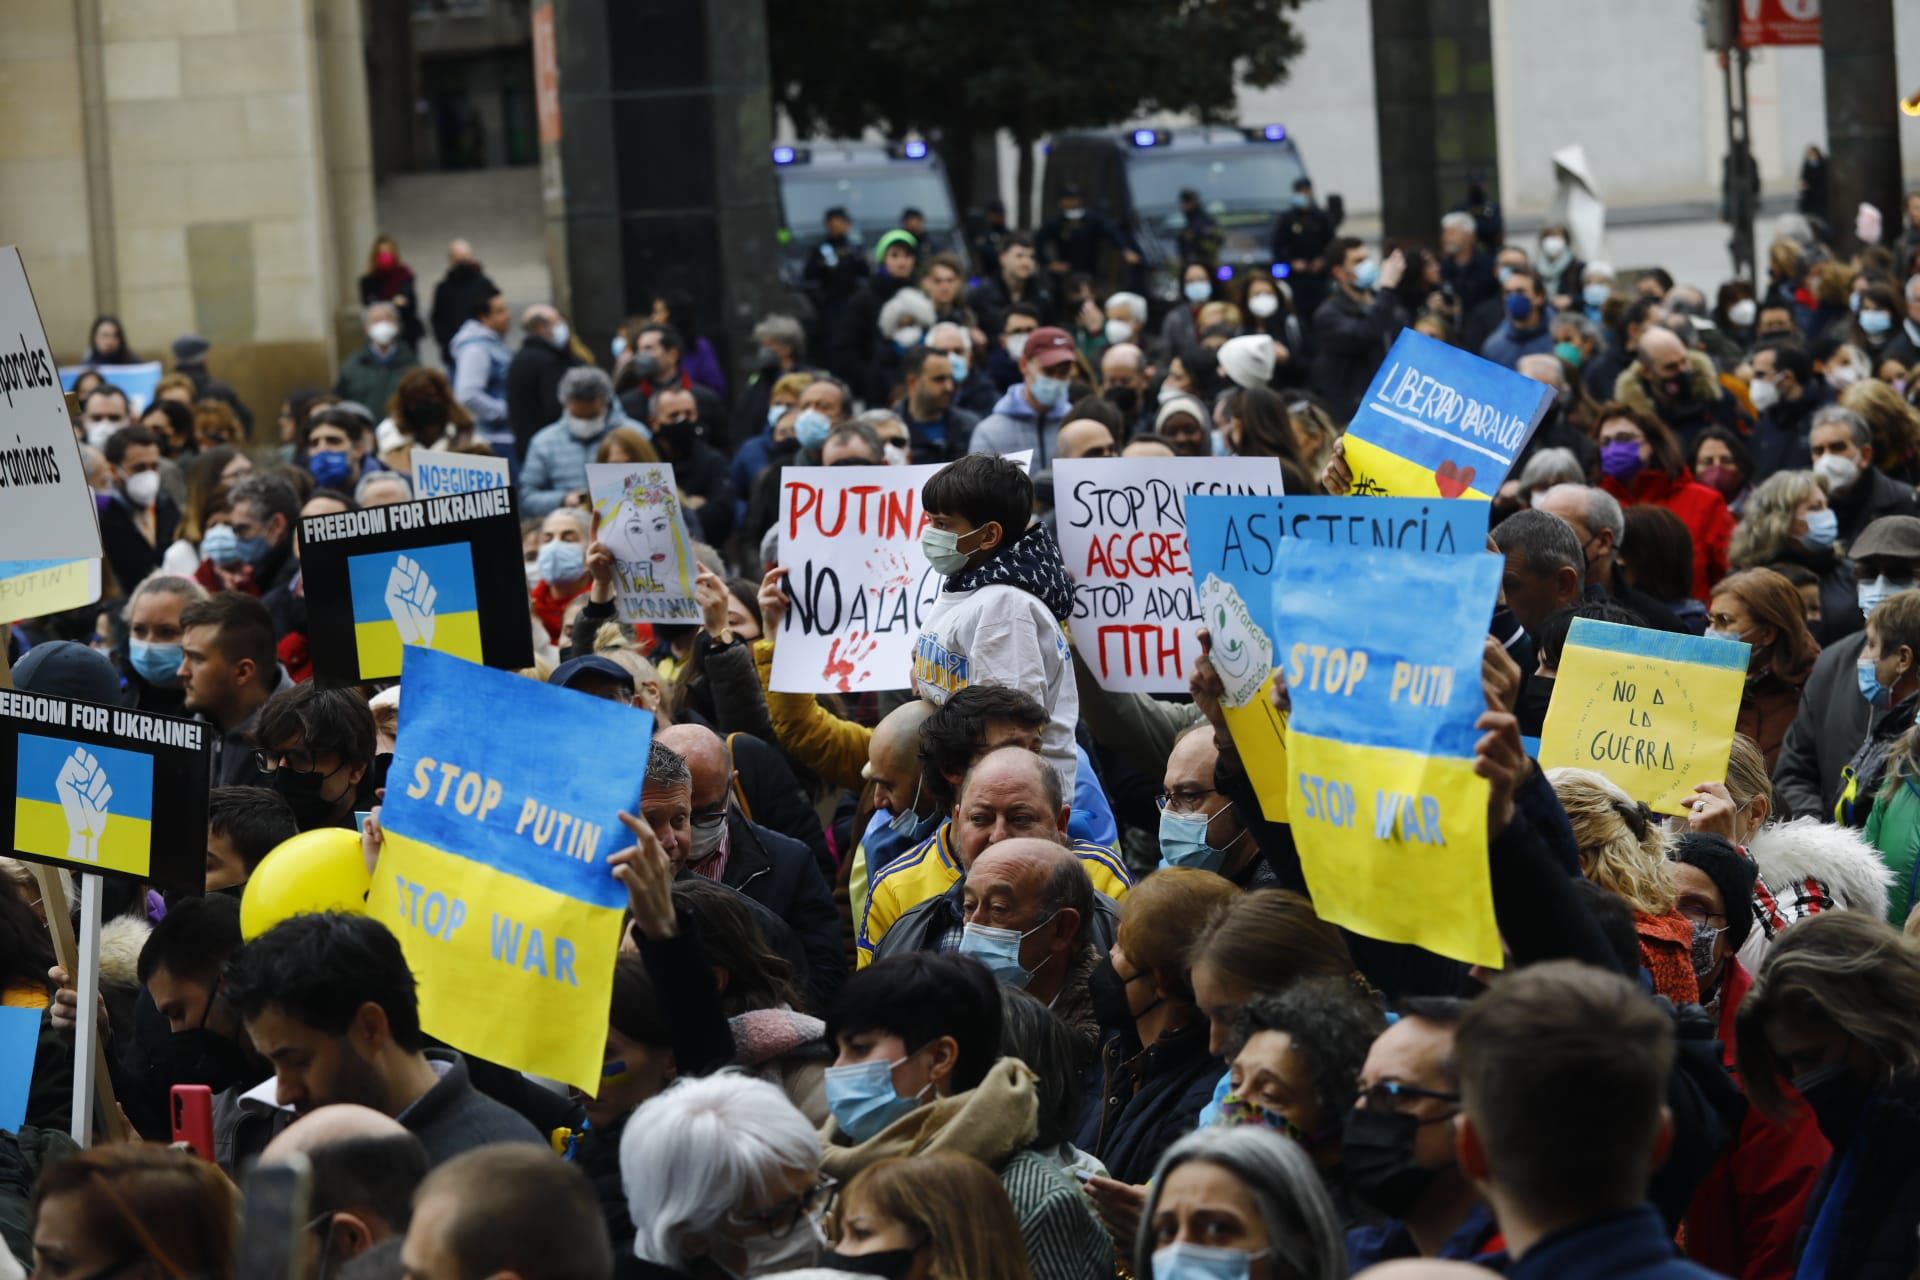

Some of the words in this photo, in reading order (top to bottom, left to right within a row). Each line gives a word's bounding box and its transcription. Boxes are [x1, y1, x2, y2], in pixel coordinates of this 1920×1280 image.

[1376, 361, 1464, 425] LIBERTAD
[1460, 398, 1500, 444] PARA
[418, 464, 441, 491] NO
[1069, 480, 1146, 530] STOP
[303, 507, 387, 544] FREEDOM
[389, 502, 425, 532] FOR
[427, 487, 511, 525] UKRAINE!
[784, 481, 914, 541] PUTIN
[780, 559, 842, 637] NO
[844, 584, 868, 633] A
[874, 586, 909, 635] LA
[1072, 582, 1134, 620] STOP
[1287, 641, 1368, 697] STOP
[1612, 679, 1637, 703] NO
[1653, 688, 1665, 705] A
[71, 703, 109, 733] FOR
[113, 711, 202, 750] UKRAINE!
[1629, 708, 1652, 728] LA
[1590, 730, 1675, 771] GUERRA
[406, 756, 503, 822] STOP
[515, 797, 602, 864] PUTIN
[1299, 773, 1356, 829] STOP
[1375, 790, 1447, 845] WAR
[490, 912, 579, 988] WAR
